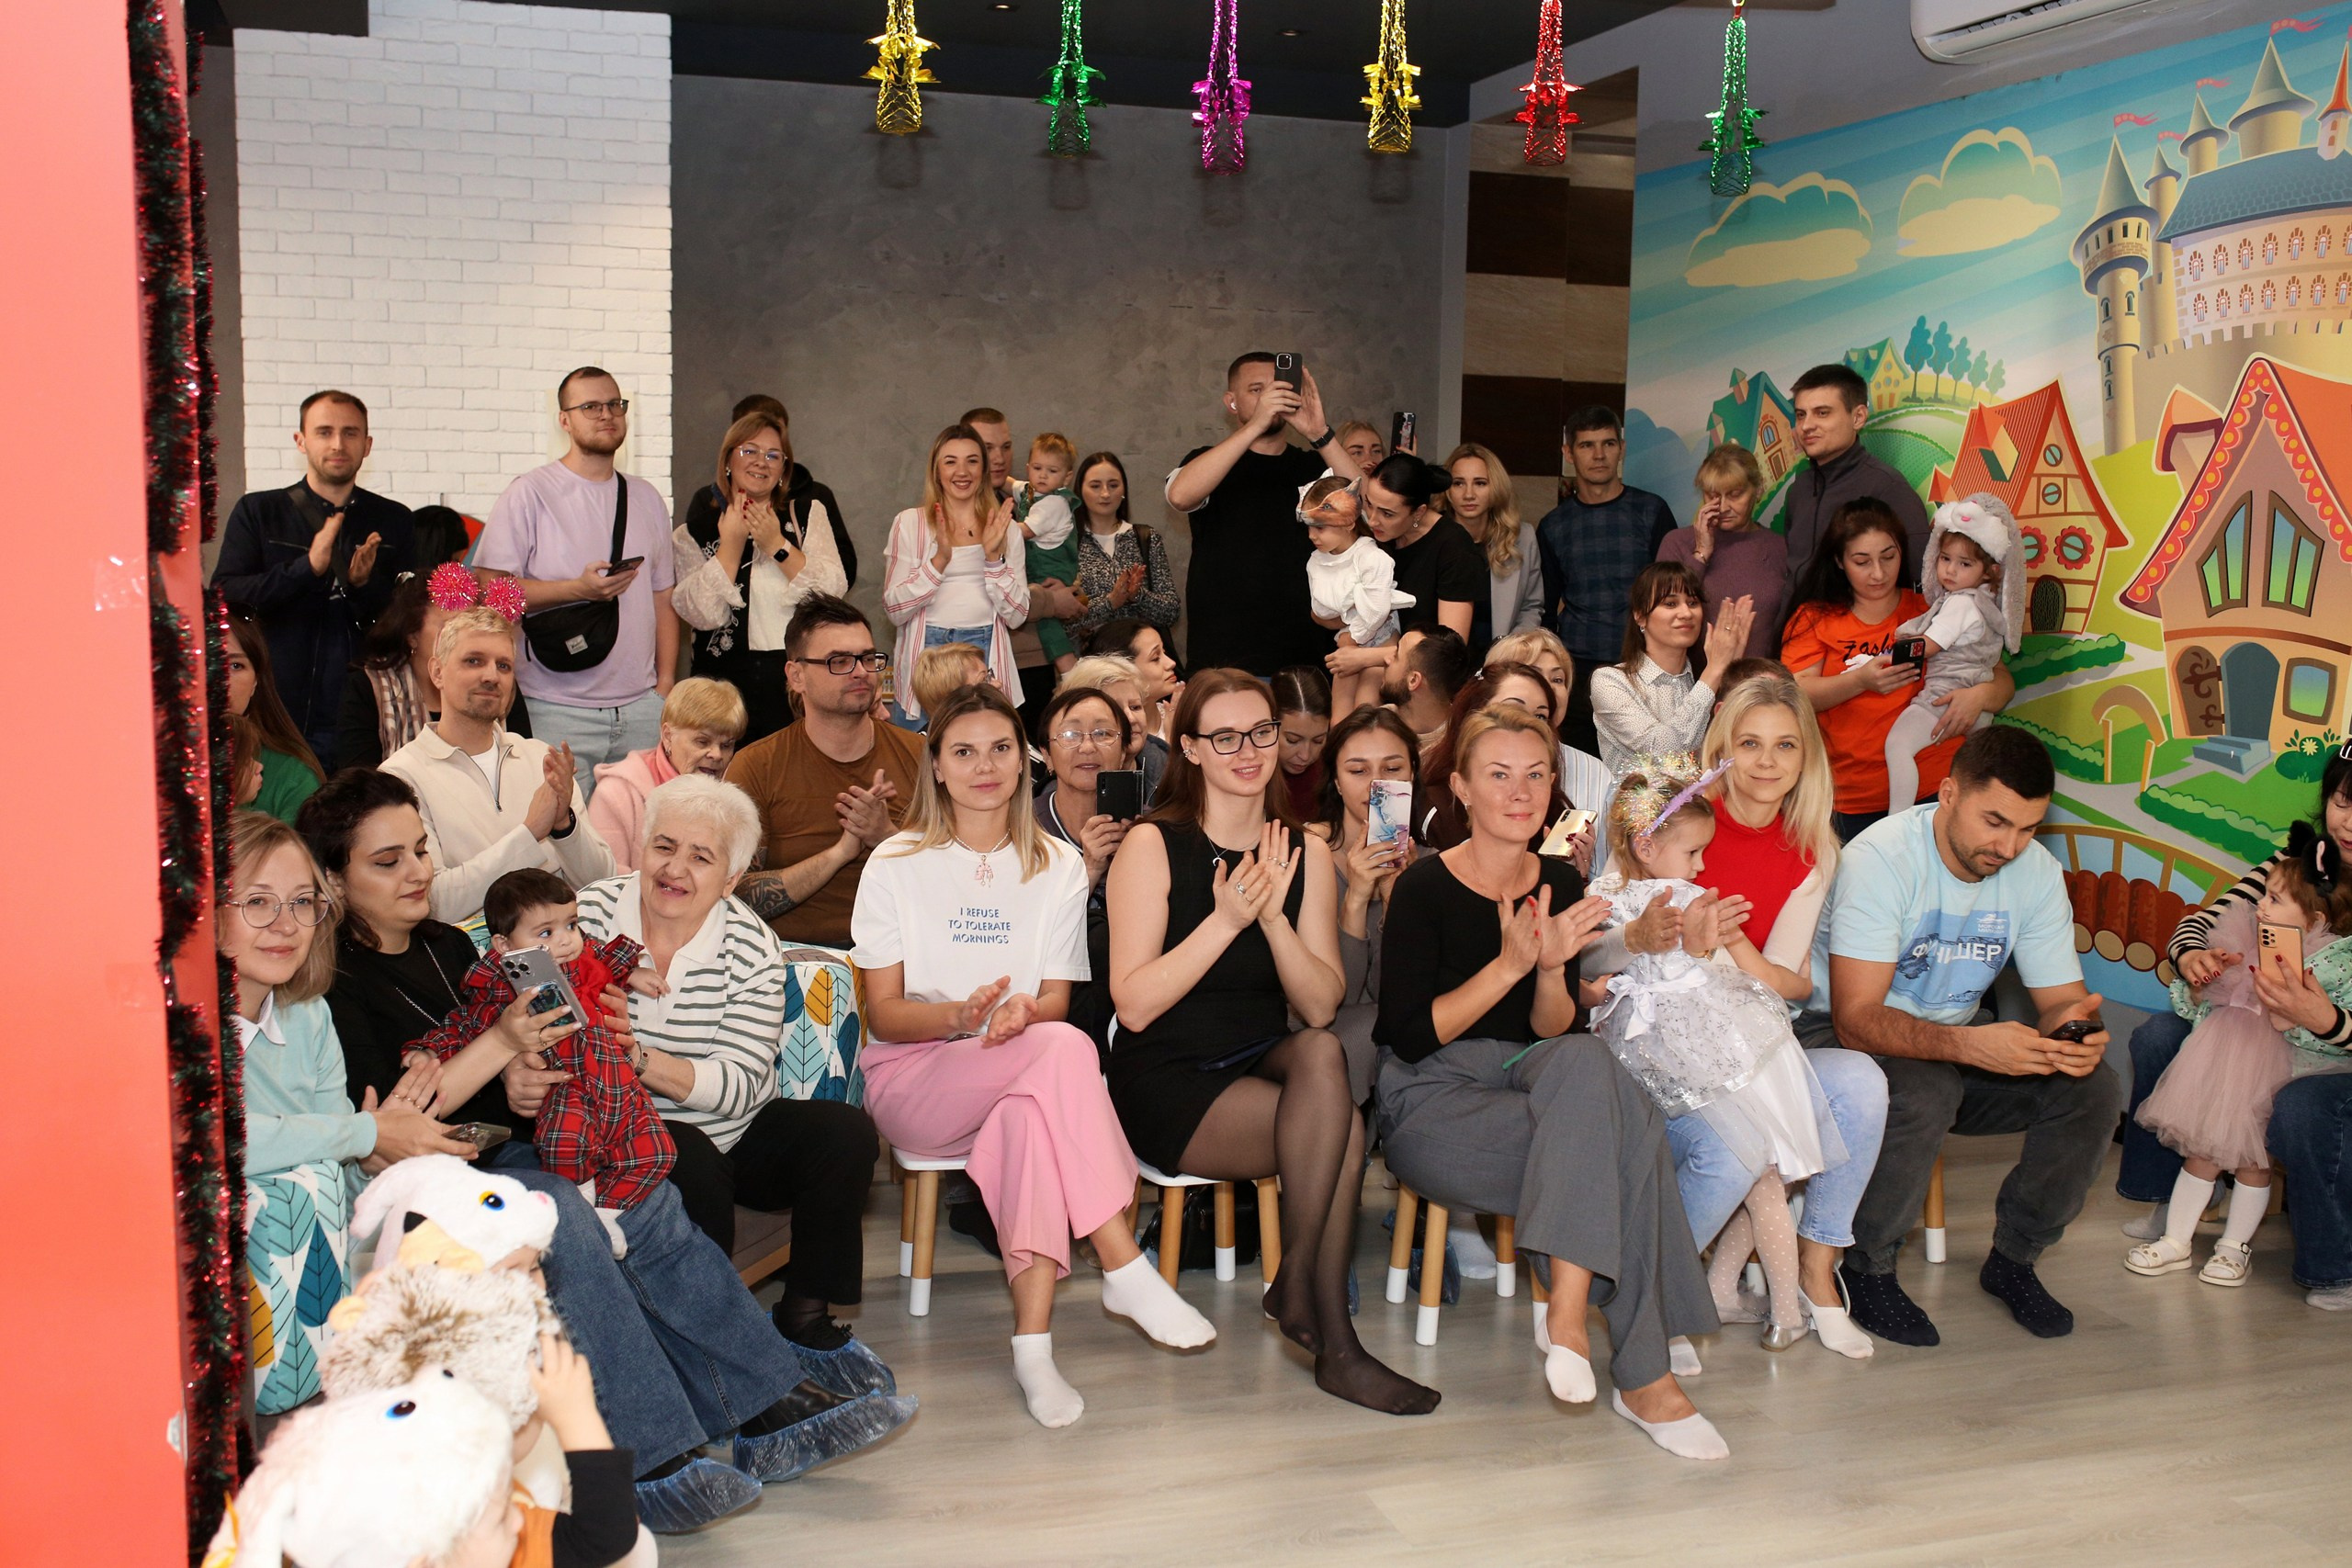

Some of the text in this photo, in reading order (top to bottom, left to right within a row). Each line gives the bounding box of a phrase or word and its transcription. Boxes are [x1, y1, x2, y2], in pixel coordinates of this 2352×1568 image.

[1838, 633, 1893, 662] Fash
[967, 908, 1000, 918] REFUSE
[948, 919, 1011, 931] TO TOLERATE
[952, 933, 1009, 944] MORNINGS
